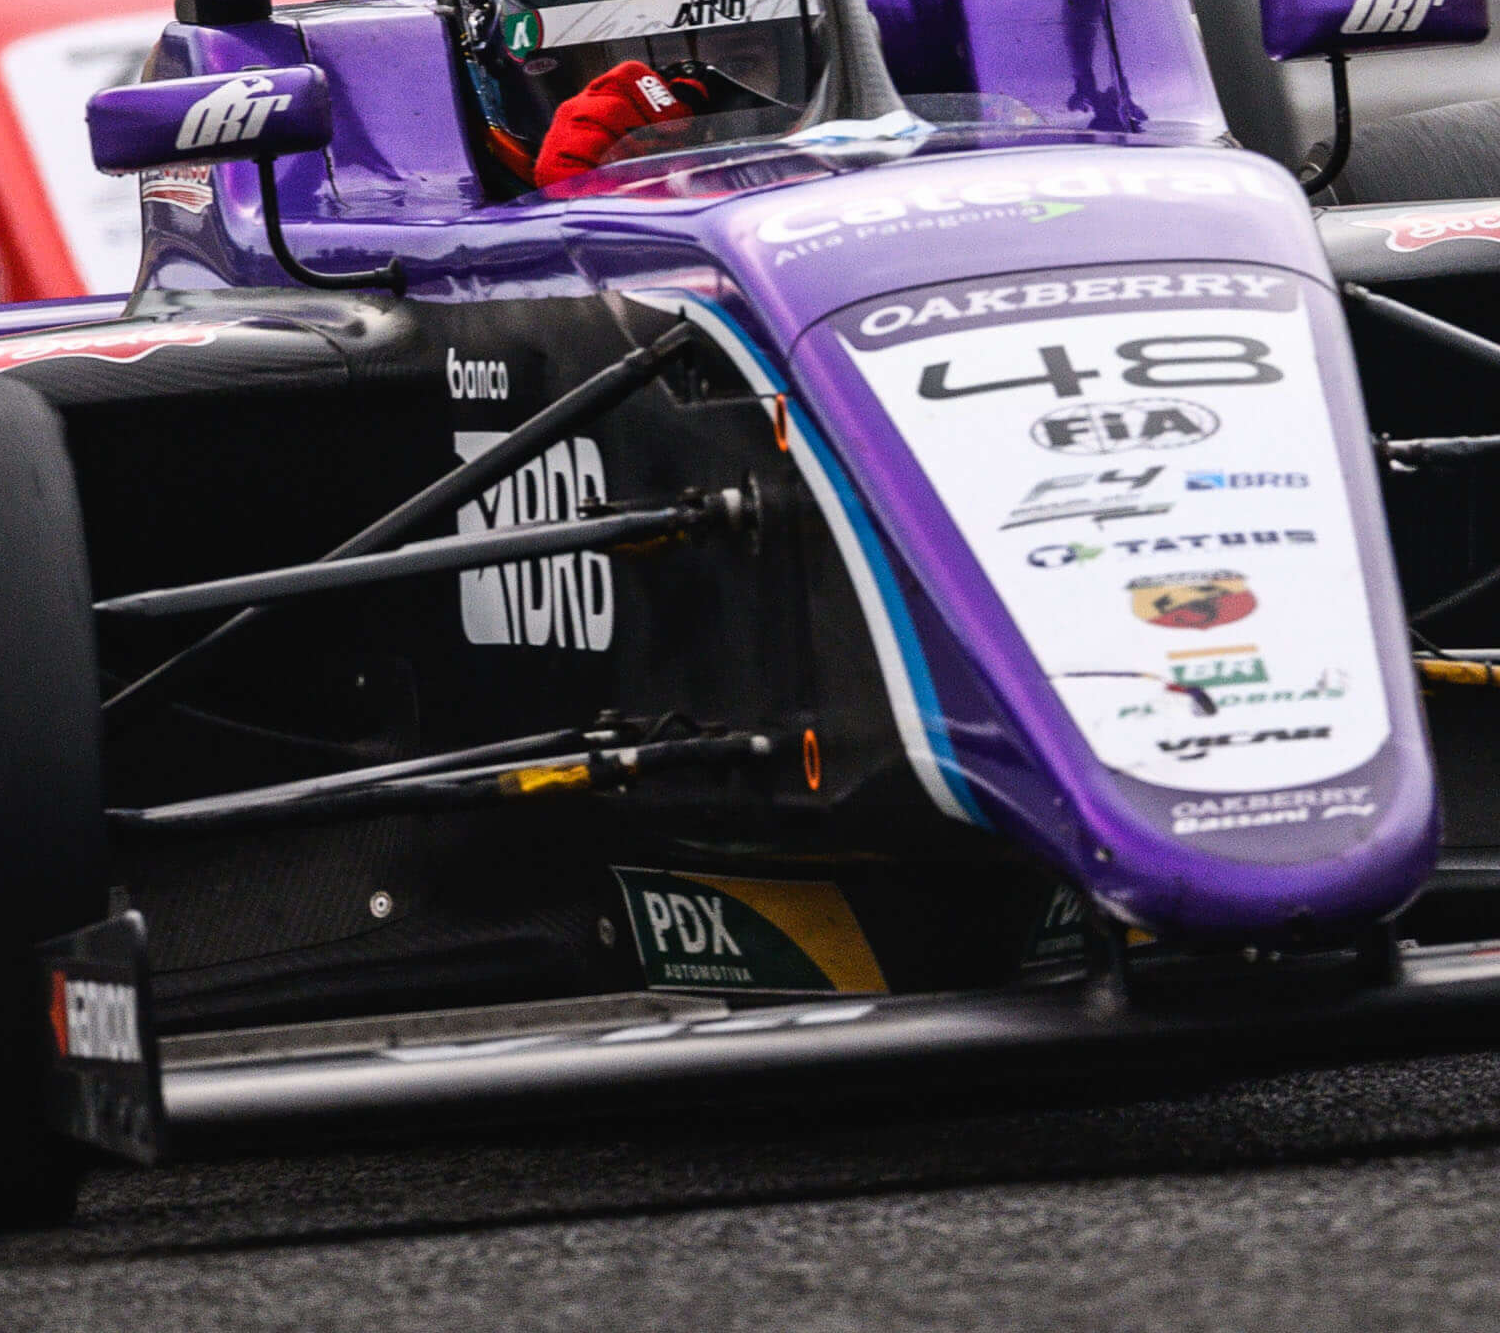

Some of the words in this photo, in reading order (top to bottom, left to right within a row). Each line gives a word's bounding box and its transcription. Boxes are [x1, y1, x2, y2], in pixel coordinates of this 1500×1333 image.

[637, 75, 676, 110] OMP
[755, 164, 1282, 245] Catedral
[773, 233, 843, 267] Alta
[855, 203, 1046, 241] Patagonia
[859, 271, 1290, 337] OAKBERRY
[446, 346, 509, 401] banco
[916, 334, 1285, 401] 48
[1227, 470, 1312, 490] BRB
[1170, 785, 1373, 819] OAKBERRY
[642, 890, 743, 957] PDX
[663, 963, 753, 982] AUTOMOTIVA
